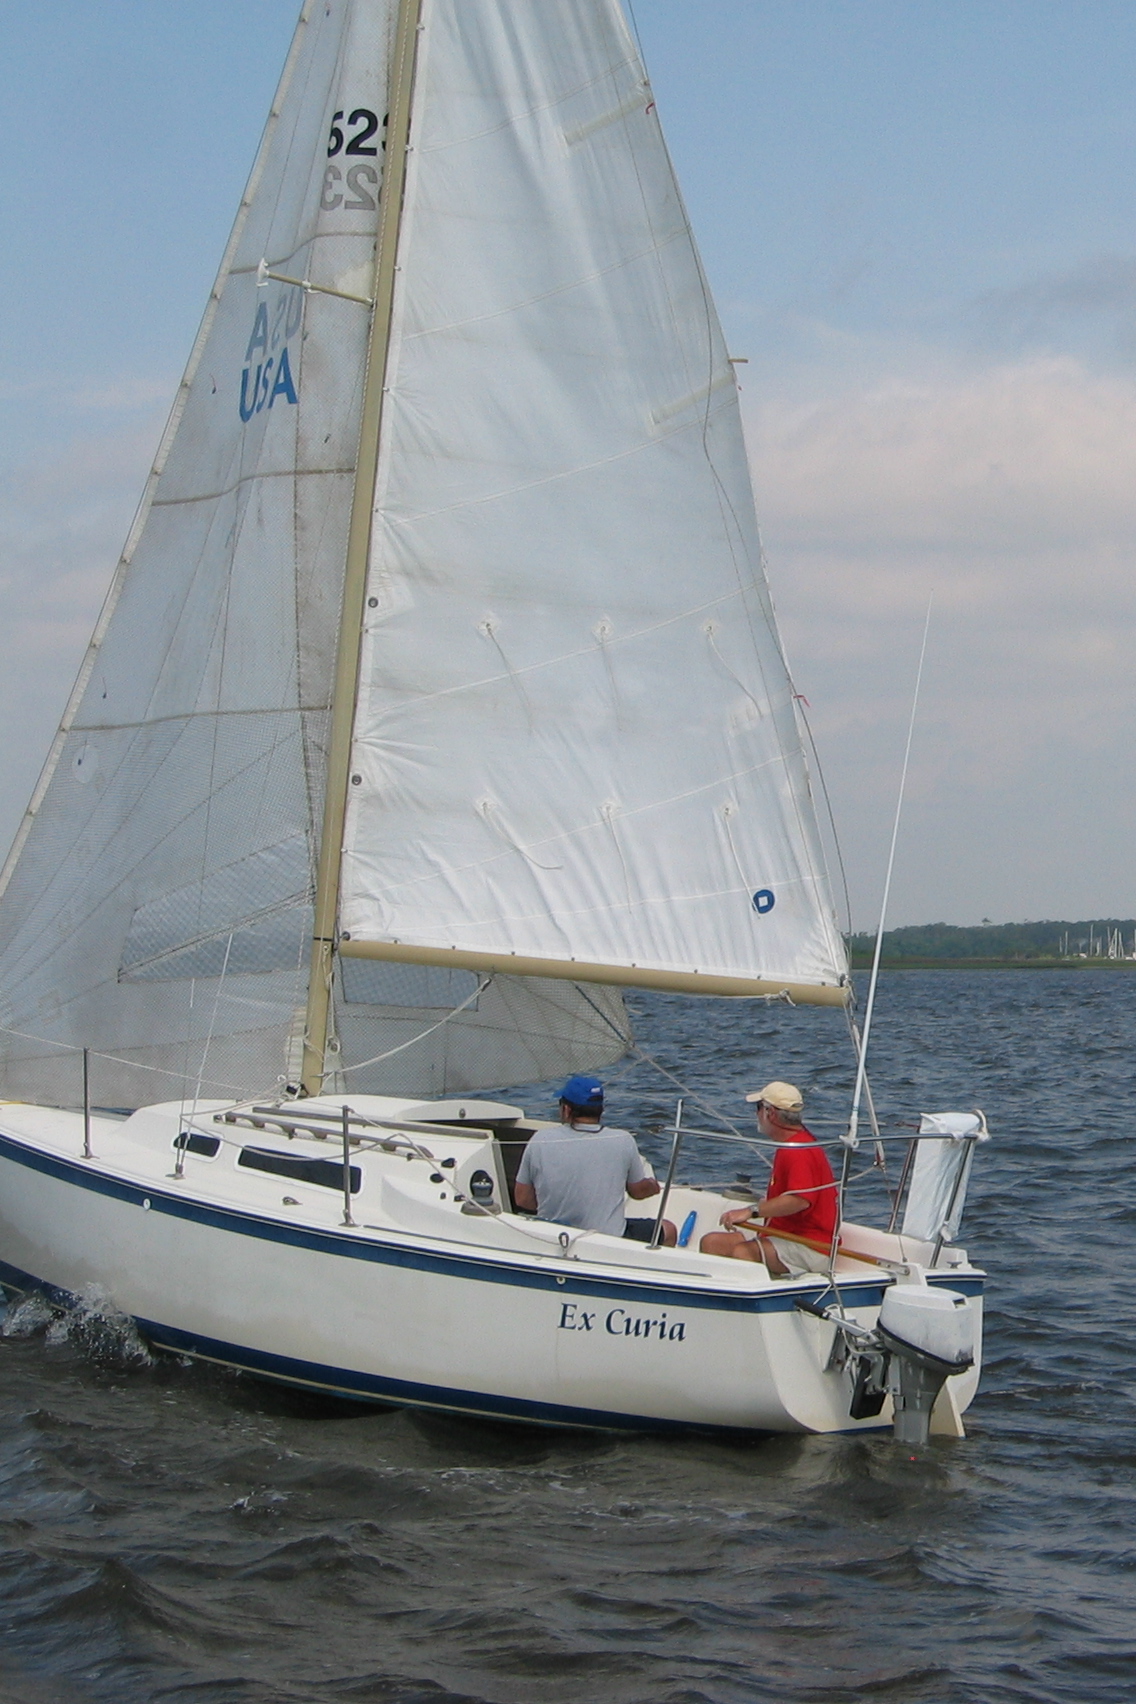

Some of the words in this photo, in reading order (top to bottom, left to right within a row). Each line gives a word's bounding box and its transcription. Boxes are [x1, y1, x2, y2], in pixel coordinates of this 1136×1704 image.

[327, 108, 389, 158] 62
[239, 346, 299, 423] USA
[557, 1302, 596, 1331] Ex
[605, 1308, 687, 1342] Curia
